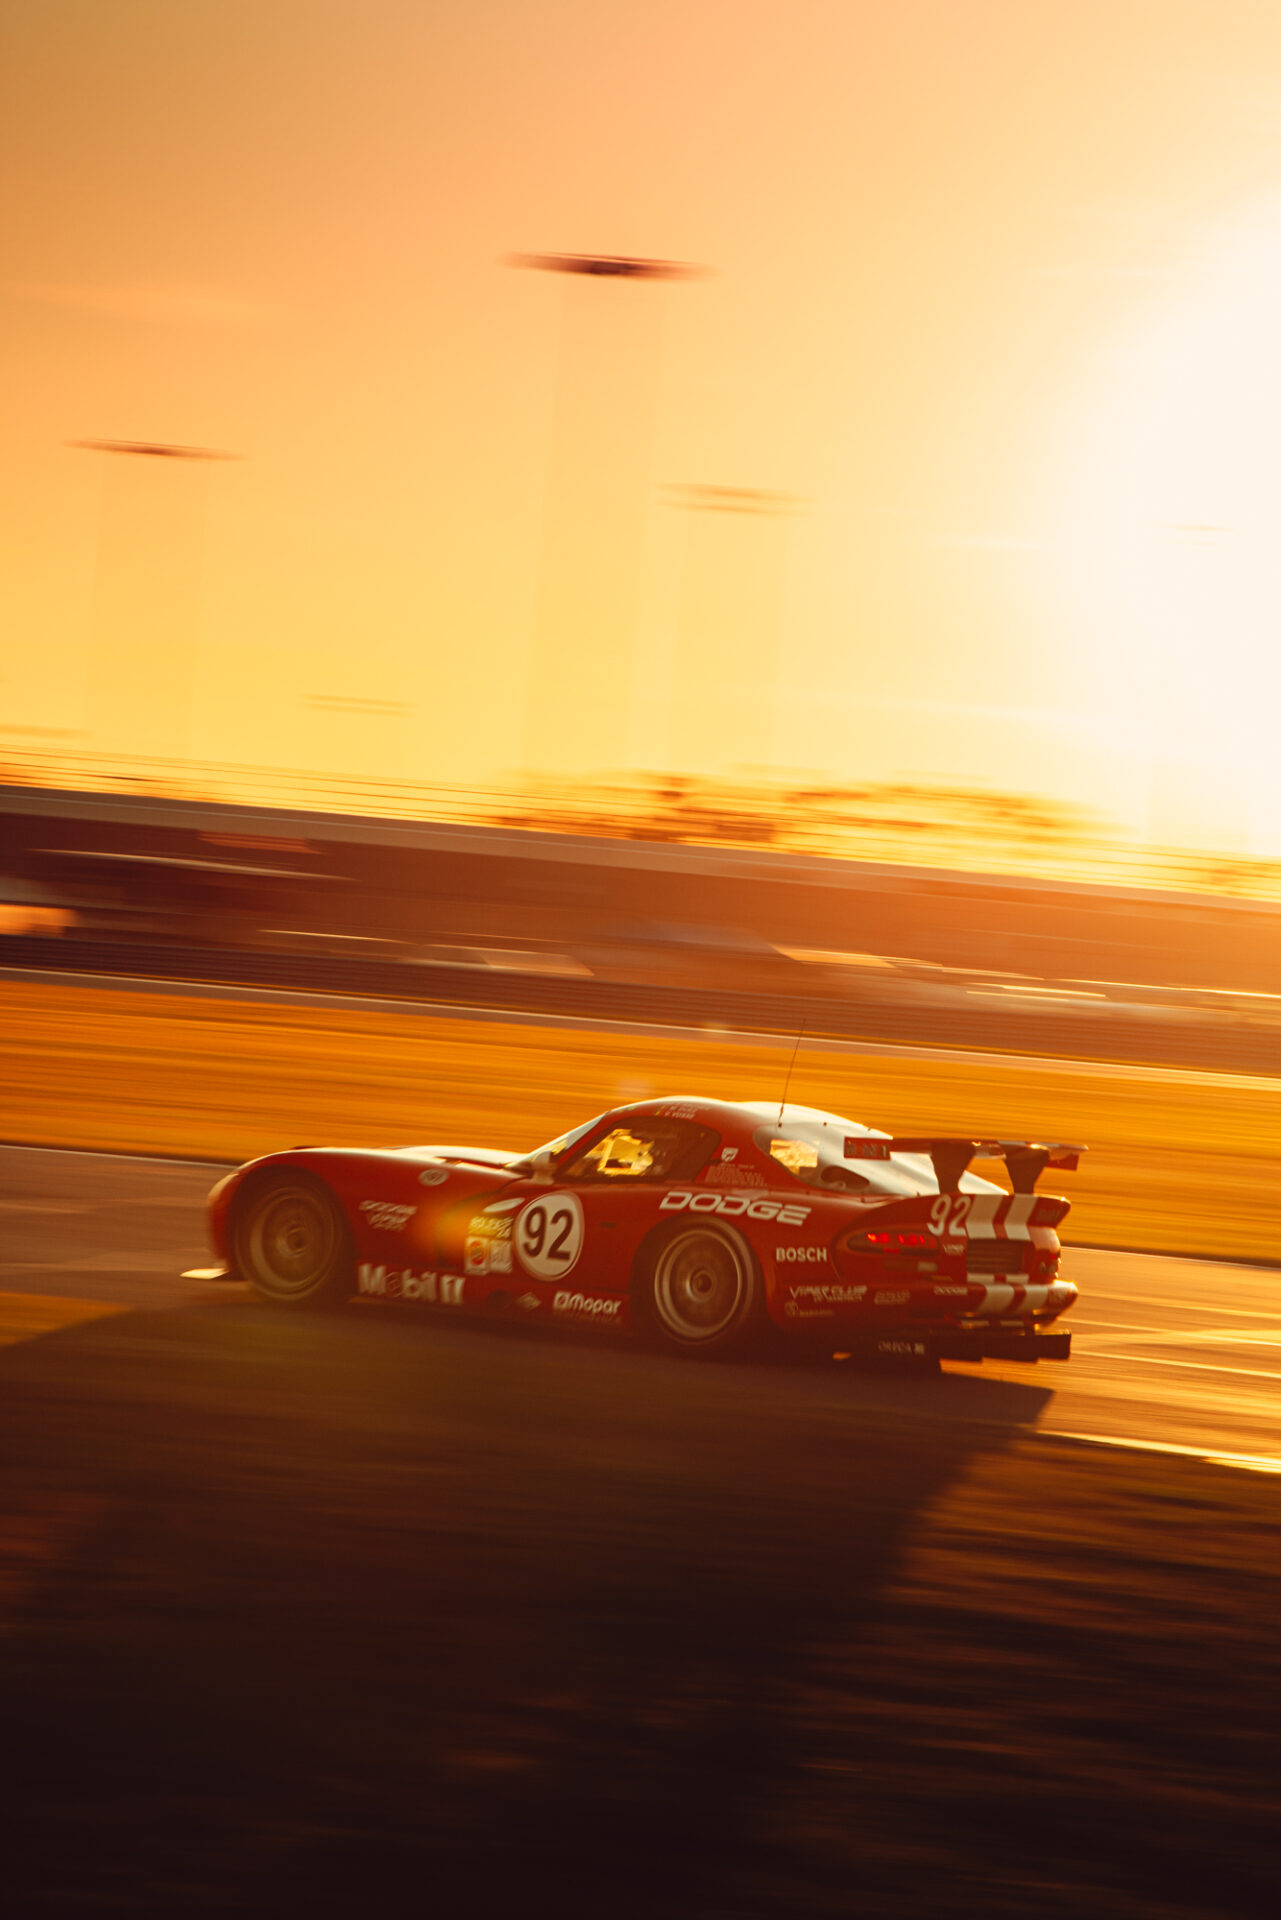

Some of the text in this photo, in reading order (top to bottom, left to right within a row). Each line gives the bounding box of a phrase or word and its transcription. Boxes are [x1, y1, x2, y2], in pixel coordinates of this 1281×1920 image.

[659, 1191, 811, 1226] DODGE
[928, 1194, 970, 1236] 92
[524, 1204, 574, 1261] 92
[776, 1247, 828, 1263] BOSCH
[358, 1263, 438, 1302] Mobil
[569, 1292, 622, 1315] Mopar
